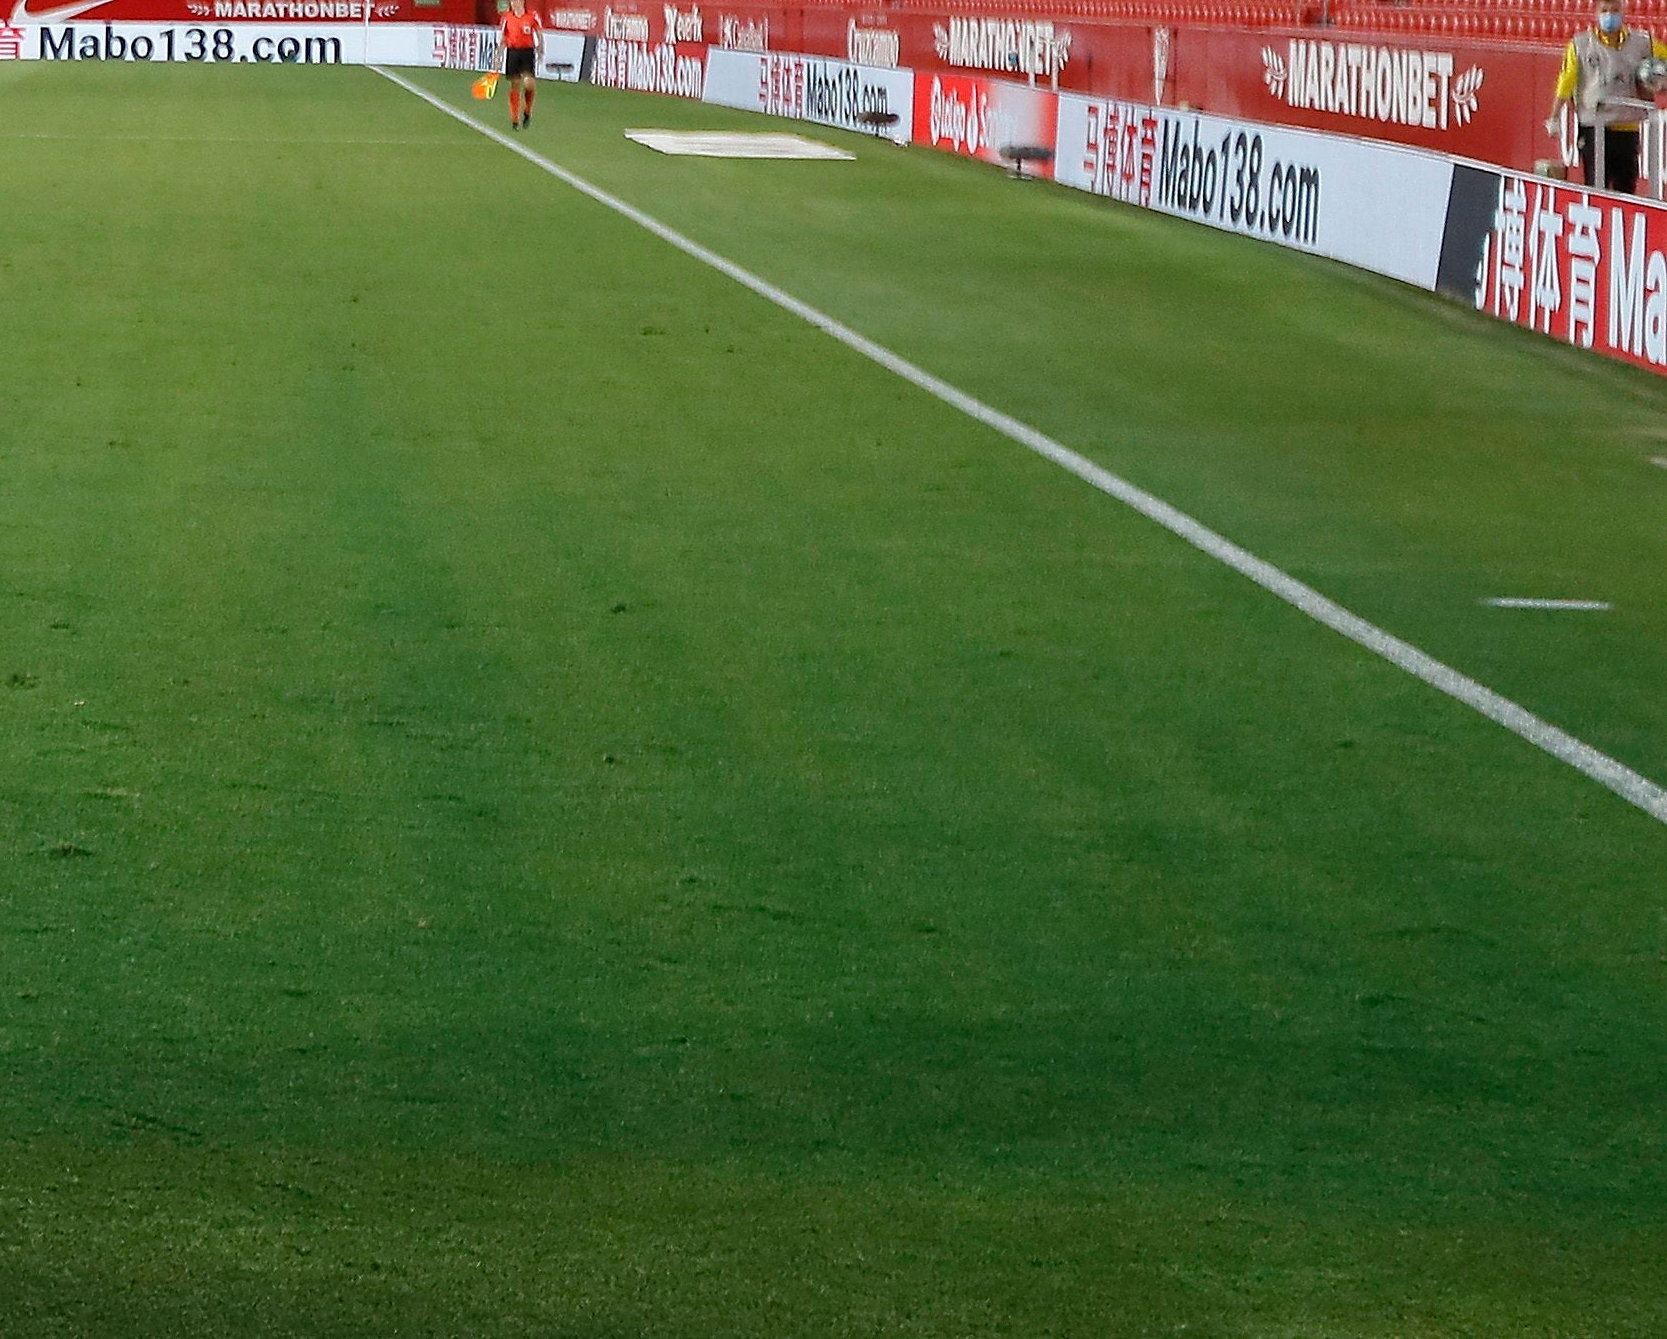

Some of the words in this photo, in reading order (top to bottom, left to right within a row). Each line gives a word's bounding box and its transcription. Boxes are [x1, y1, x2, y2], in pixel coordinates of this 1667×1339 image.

[213, 0, 375, 19] MARATHONBET
[38, 26, 342, 62] Mabo138.com
[628, 41, 703, 99] Mabo138.com
[1287, 38, 1454, 130] MARATHONBET
[1084, 104, 1157, 208] 马博体育
[1158, 118, 1321, 244] Mabo138.com
